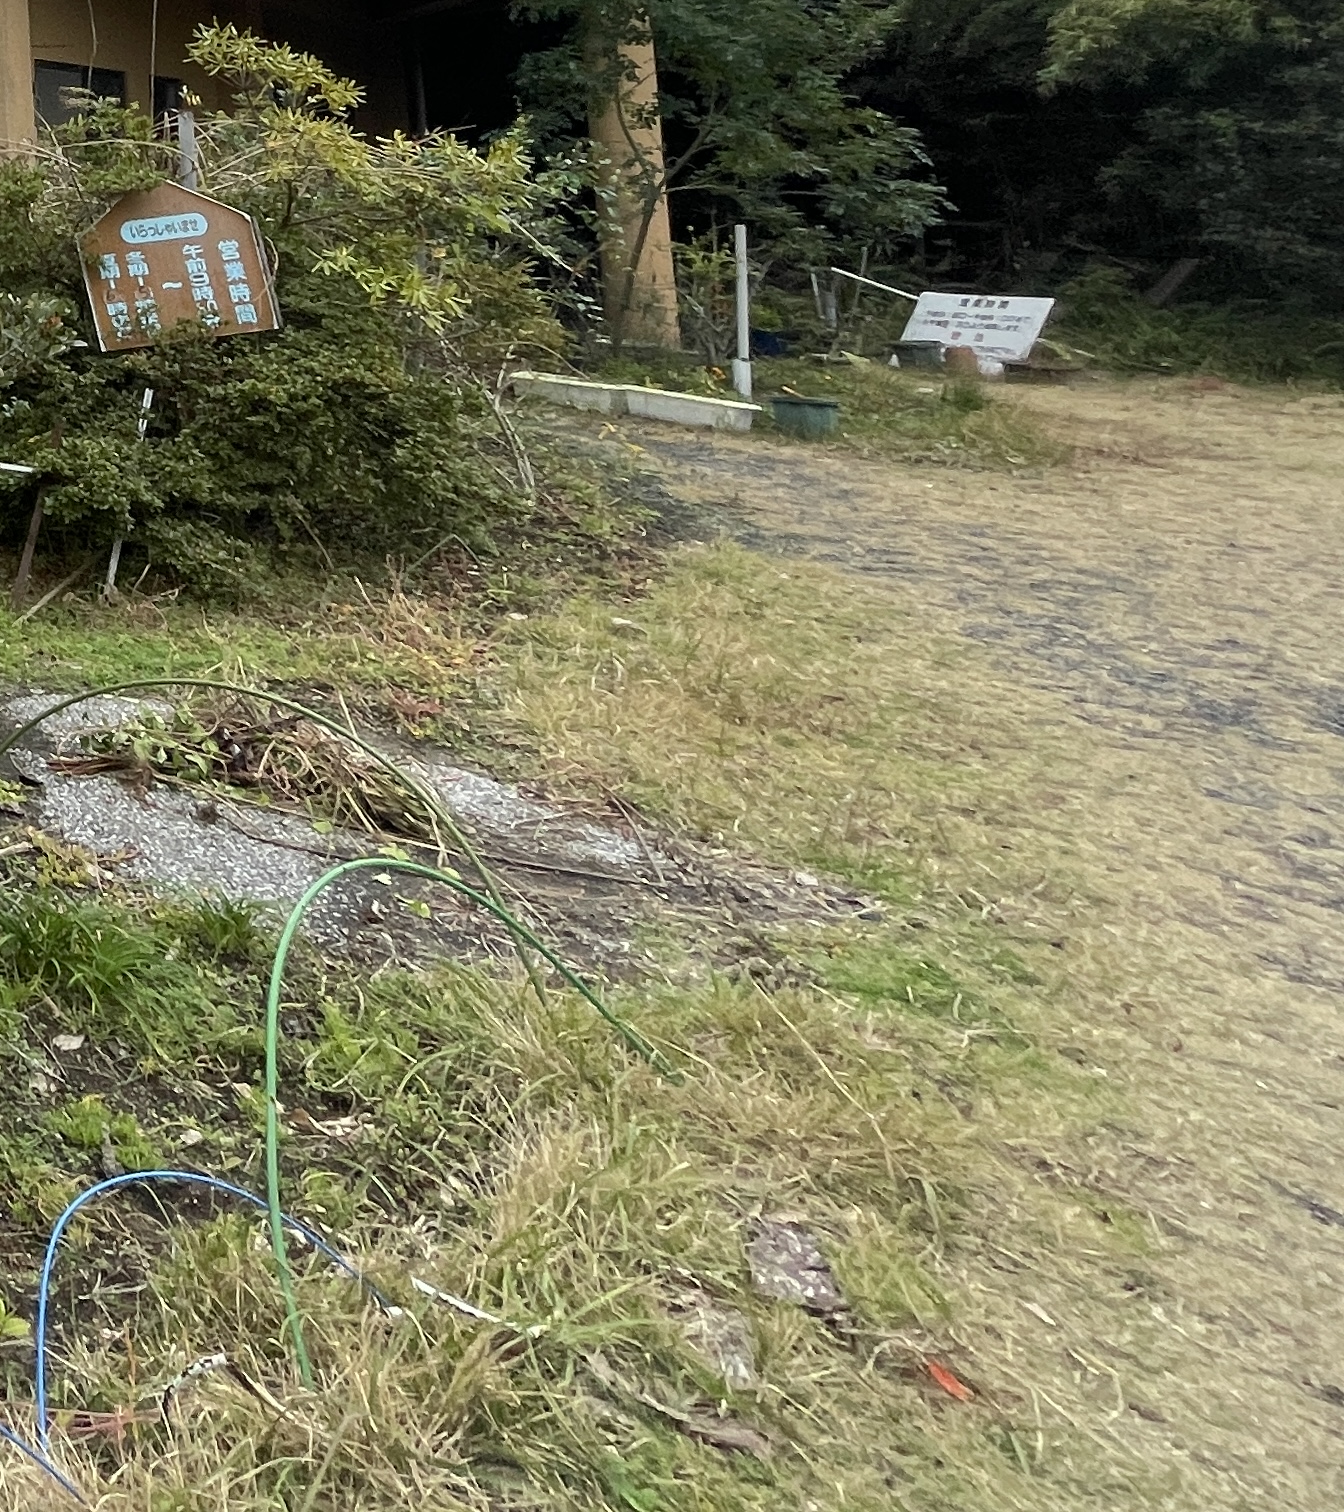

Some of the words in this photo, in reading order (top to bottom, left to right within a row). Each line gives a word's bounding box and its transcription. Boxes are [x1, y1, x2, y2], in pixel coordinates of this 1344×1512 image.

[128, 219, 199, 239] いらっしゃいませ
[217, 239, 258, 325] 営業時間
